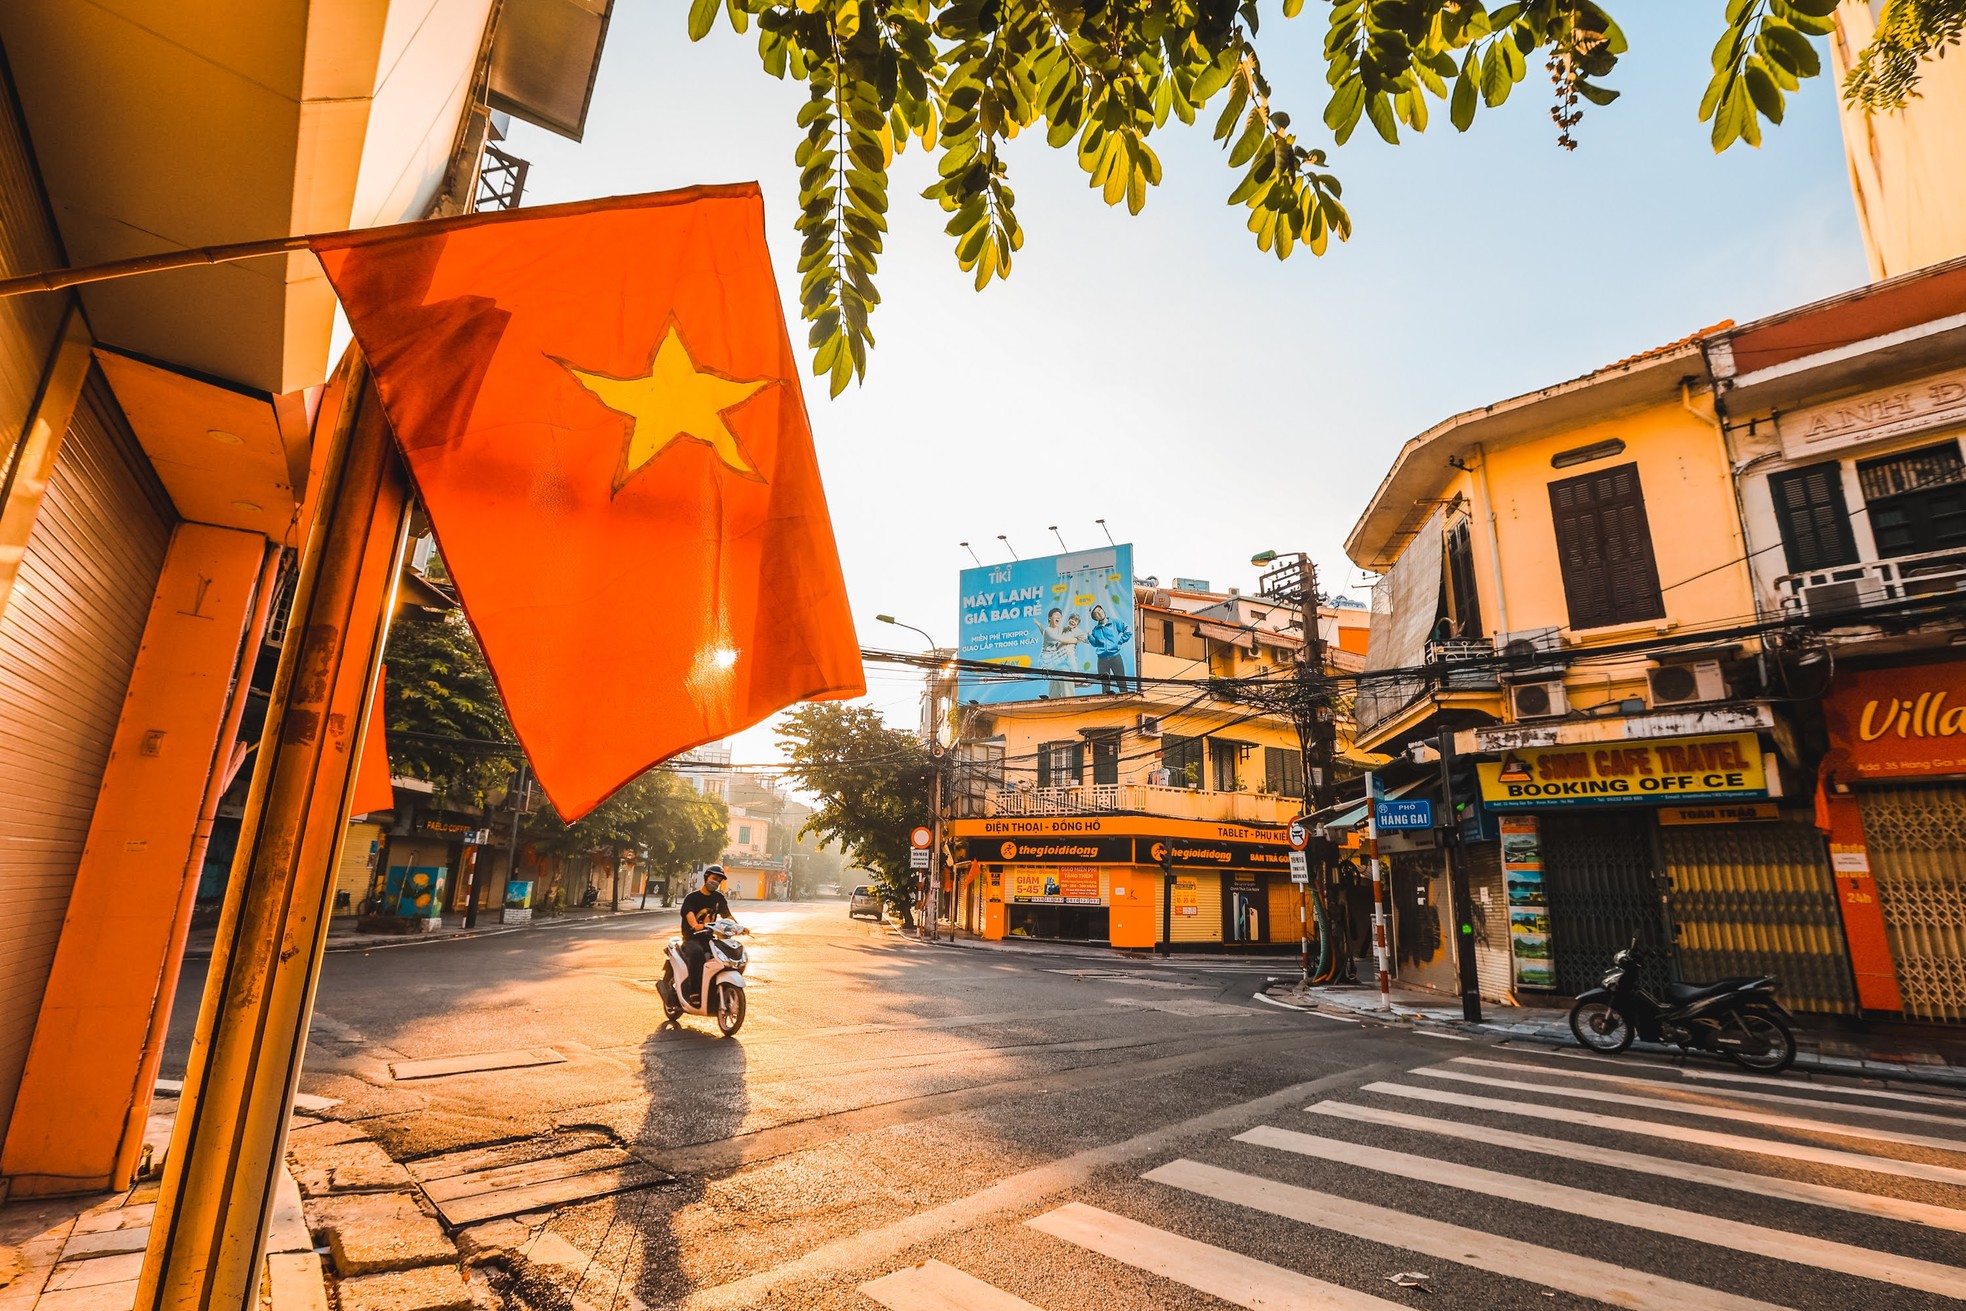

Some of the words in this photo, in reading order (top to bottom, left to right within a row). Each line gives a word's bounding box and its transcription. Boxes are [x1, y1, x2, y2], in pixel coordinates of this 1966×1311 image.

[1804, 392, 1915, 437] ANH
[963, 590, 996, 609] MÁY
[999, 585, 1044, 605] LẠNH
[964, 608, 988, 624] GIÁ
[1023, 600, 1042, 618] RẺ
[989, 631, 1001, 641] PHÍ
[1001, 630, 1029, 639] TIKIPRO
[994, 640, 1018, 649] TRONG
[1859, 691, 1966, 742] Villa
[1594, 747, 1653, 777] CAFE
[1655, 741, 1750, 773] TRAVEL
[1900, 761, 1931, 770] Hang
[1508, 779, 1629, 797] BOOKING
[1398, 801, 1415, 810] PHỐ
[1381, 813, 1408, 825] HÀNG
[1410, 814, 1427, 824] GAI
[985, 821, 1009, 834] ĐIỆN
[1011, 823, 1043, 834] THOẠI
[1218, 828, 1249, 838] TABLET
[1255, 831, 1272, 842] PHỤ
[1019, 846, 1099, 857] thegioididong
[1829, 843, 1867, 853] Made
[1170, 848, 1232, 862] hegioididong
[1250, 853, 1264, 862] BÁN
[1265, 853, 1279, 862] TRẢ
[1016, 874, 1040, 884] GIẢM
[1847, 893, 1872, 903] 24h
